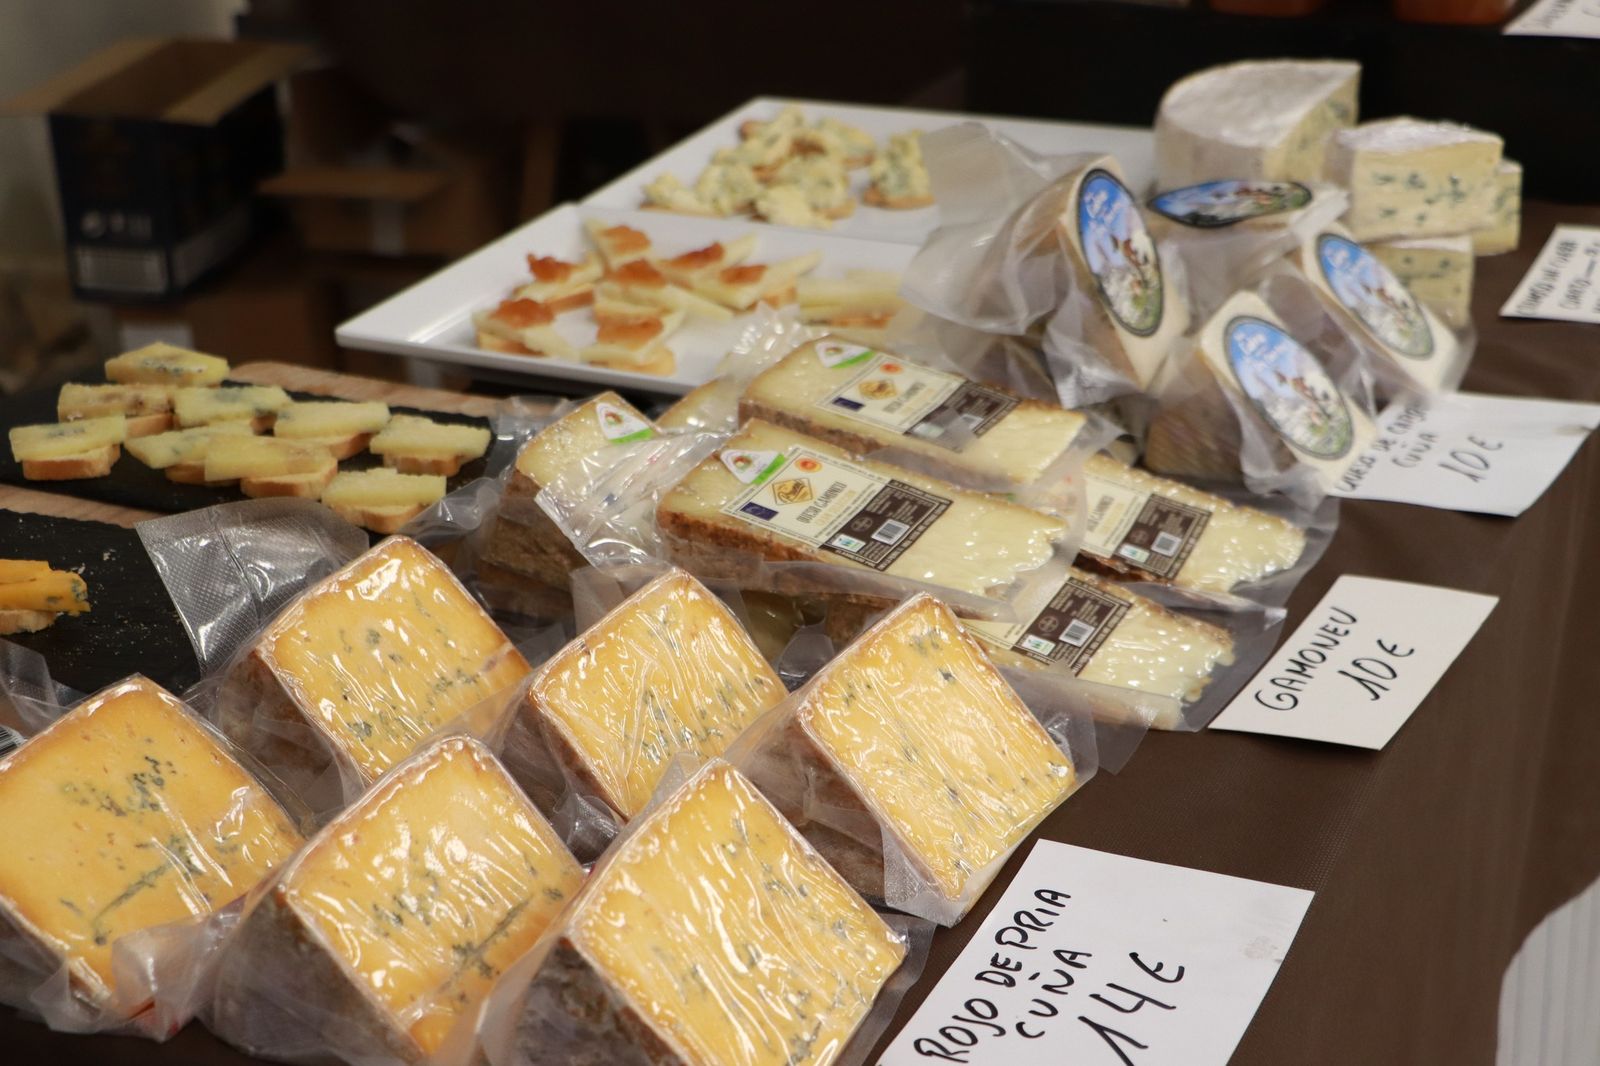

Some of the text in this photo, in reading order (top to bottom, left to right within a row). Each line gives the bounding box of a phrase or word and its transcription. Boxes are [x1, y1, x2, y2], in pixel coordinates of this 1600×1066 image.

[1391, 432, 1437, 468] CUÑA
[1254, 606, 1358, 711] GAMONEU
[913, 997, 1008, 1064] ROJO
[1015, 948, 1093, 1040] CUÑA
